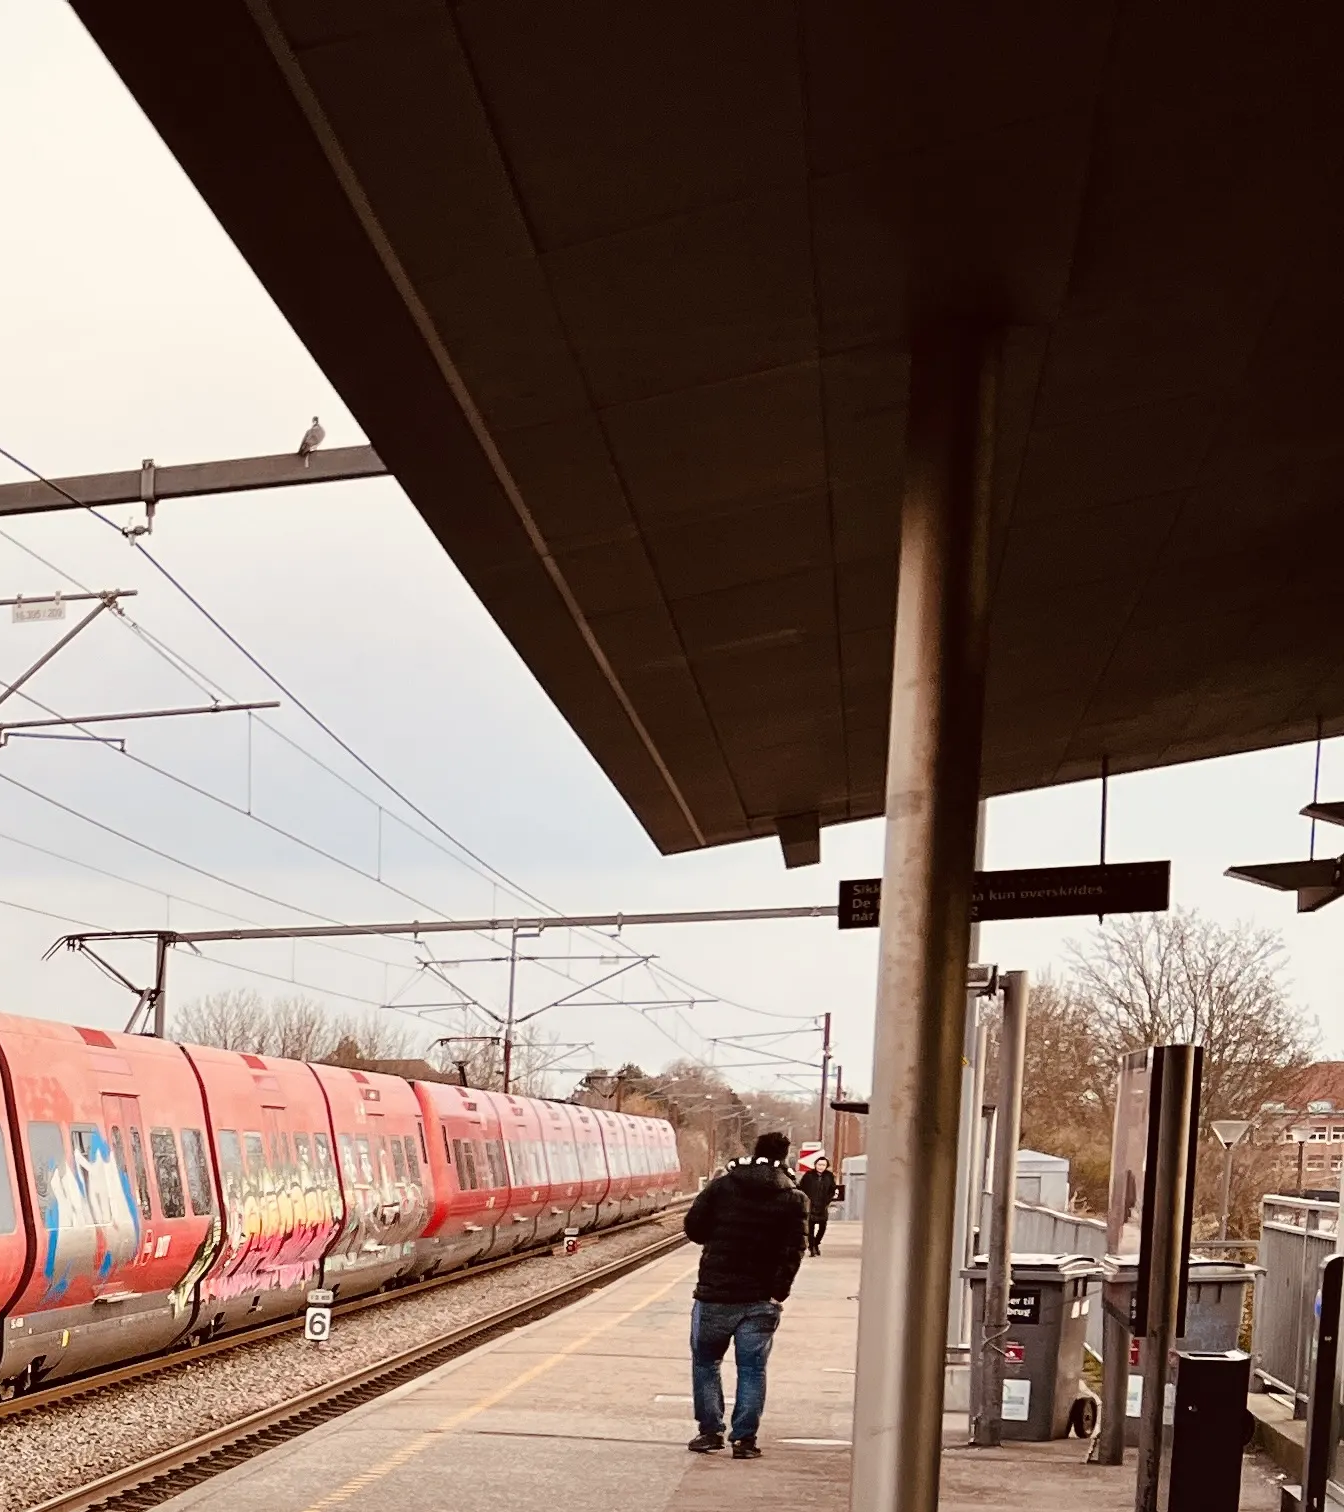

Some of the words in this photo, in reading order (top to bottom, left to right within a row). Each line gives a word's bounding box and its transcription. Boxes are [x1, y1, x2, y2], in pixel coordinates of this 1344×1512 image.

[853, 899, 871, 908] De
[989, 889, 1016, 900] kun
[566, 1239, 576, 1252] 8
[309, 1312, 327, 1336] 6
